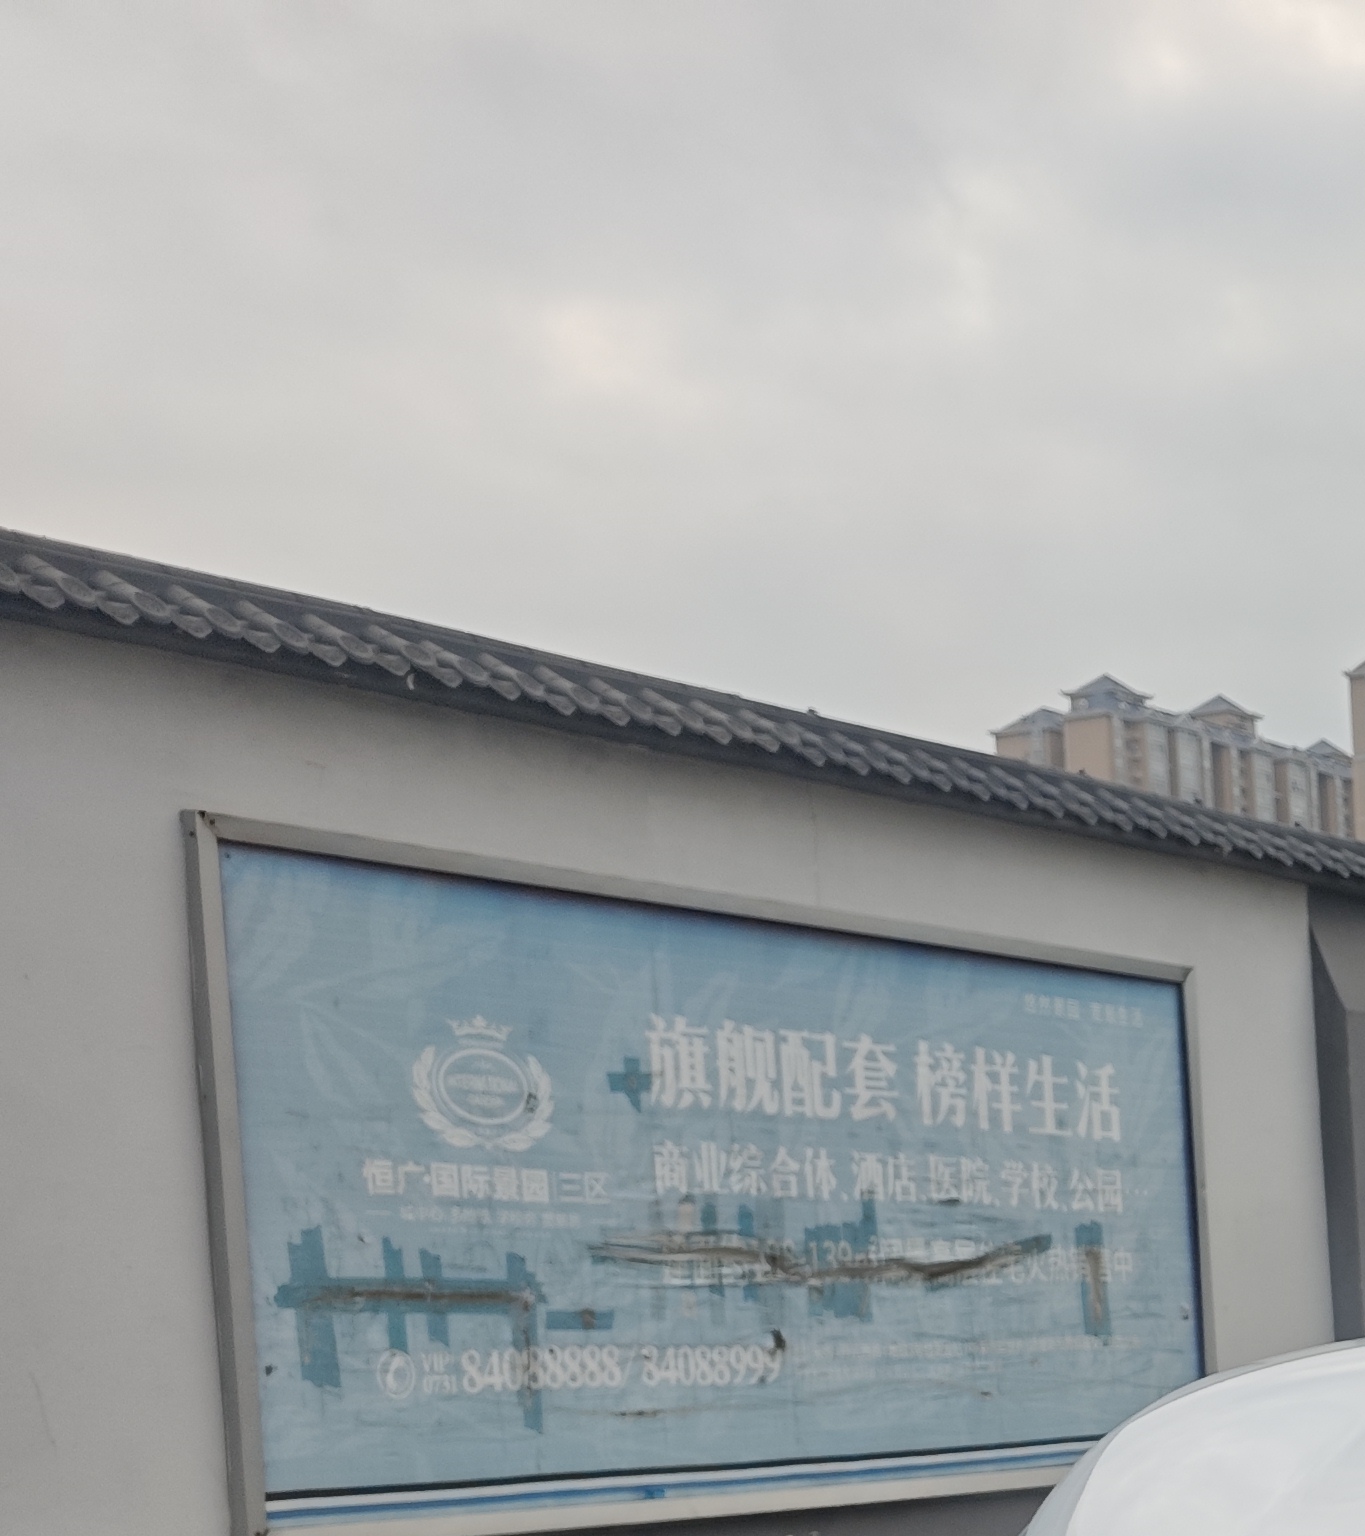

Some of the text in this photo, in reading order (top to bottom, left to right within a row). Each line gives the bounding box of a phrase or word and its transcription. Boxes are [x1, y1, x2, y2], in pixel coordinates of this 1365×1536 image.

[645, 1012, 1122, 1143] 旗舰配套 榜样生活
